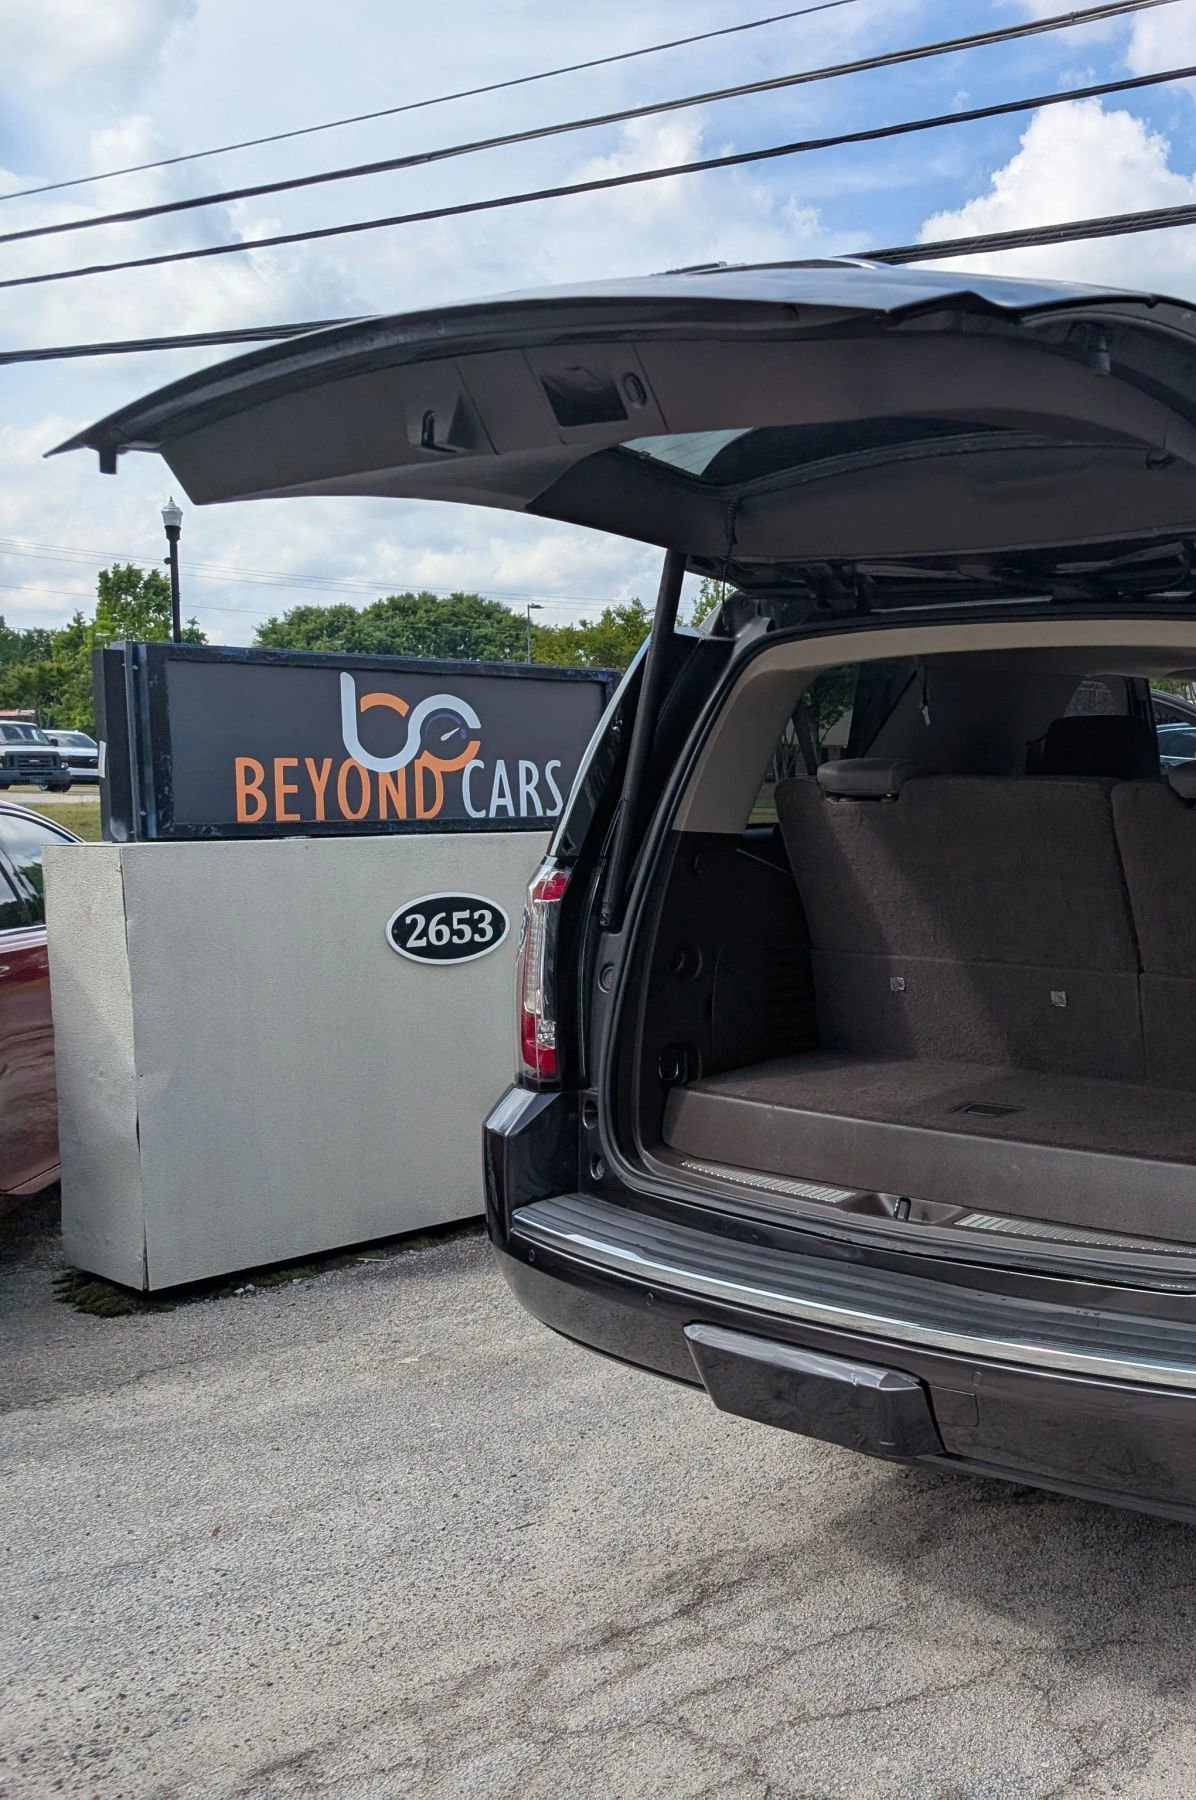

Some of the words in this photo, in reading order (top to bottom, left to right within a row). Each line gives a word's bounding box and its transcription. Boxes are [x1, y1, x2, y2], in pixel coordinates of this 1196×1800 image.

[234, 757, 444, 822] BEYOND
[462, 758, 564, 818] CARS
[405, 909, 494, 948] 2653
